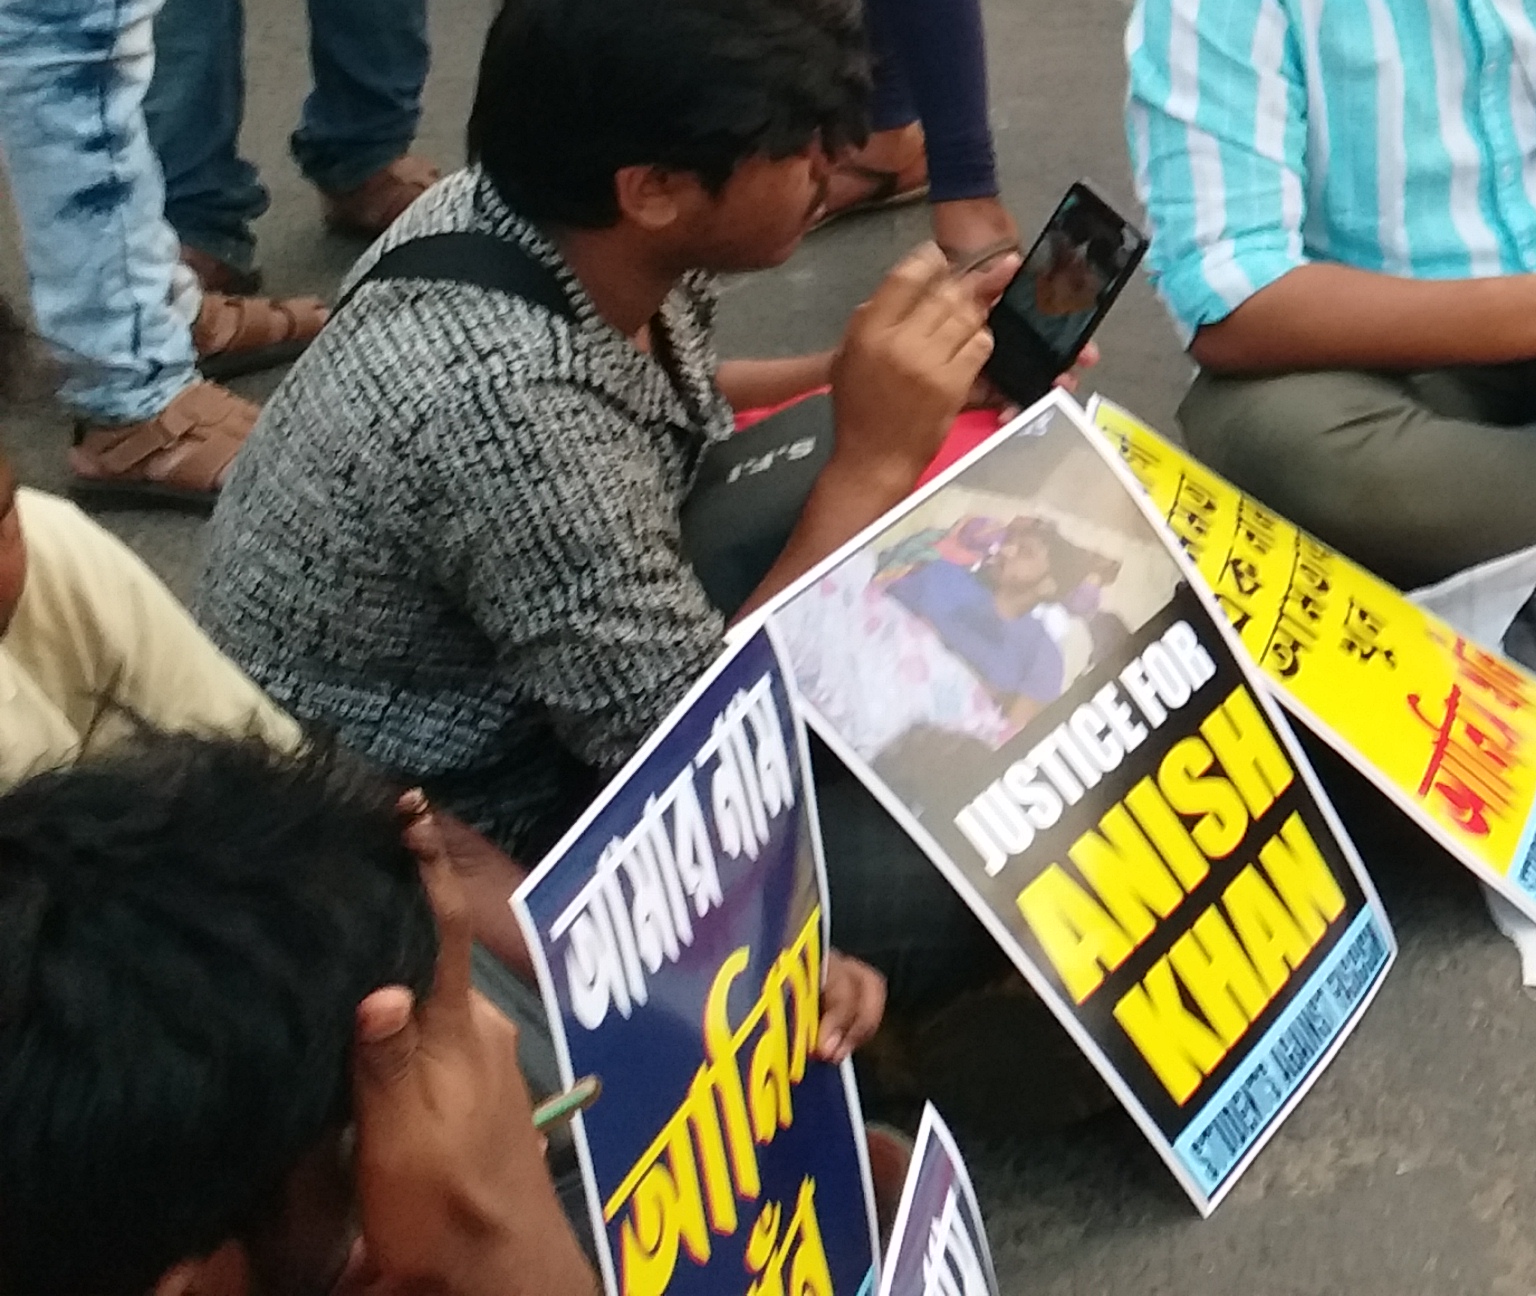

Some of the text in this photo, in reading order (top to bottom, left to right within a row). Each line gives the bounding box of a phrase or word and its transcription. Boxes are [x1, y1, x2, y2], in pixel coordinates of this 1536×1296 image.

[549, 670, 795, 1032] আমার নাম
[953, 619, 1217, 879] JUSTICE FOR
[1016, 682, 1295, 1008] ANISH
[603, 902, 824, 1296] আনিস
[1111, 810, 1347, 1108] KHAN
